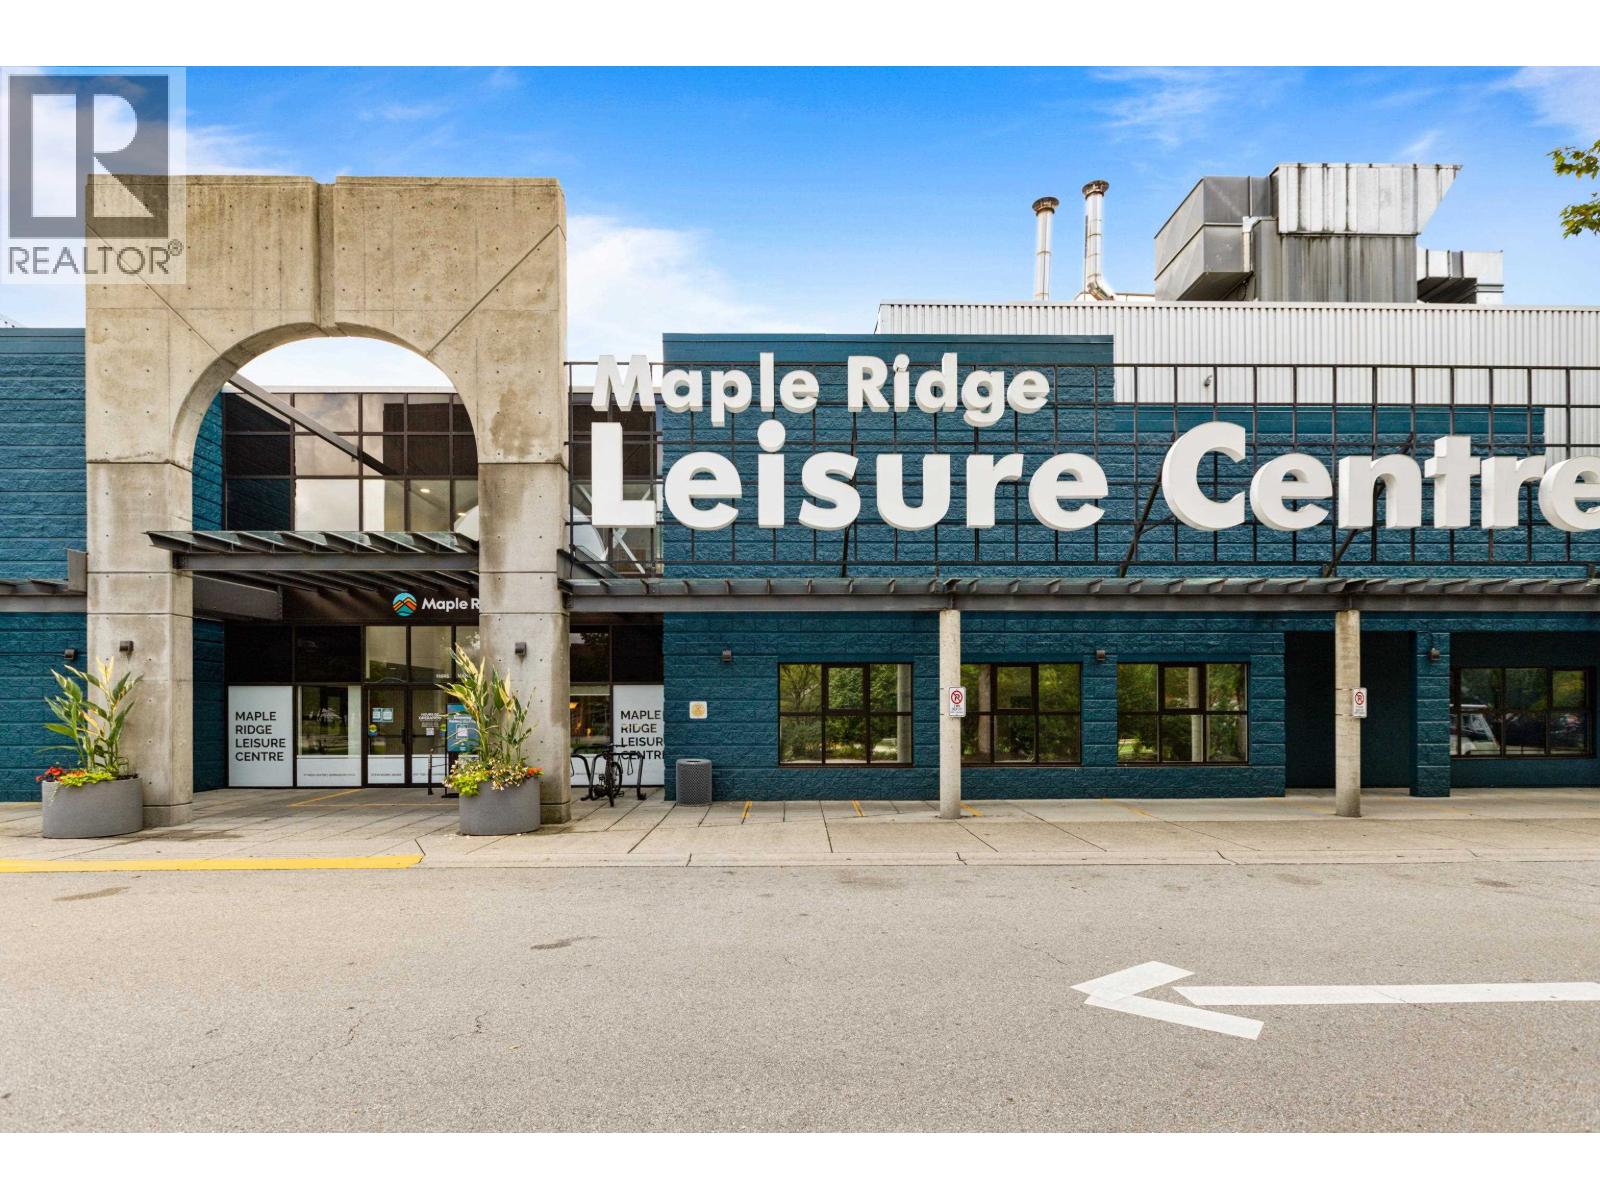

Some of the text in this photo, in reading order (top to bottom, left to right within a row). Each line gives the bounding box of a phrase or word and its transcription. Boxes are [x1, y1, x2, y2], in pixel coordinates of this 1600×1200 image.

[591, 352, 1050, 427] Maple Ridge
[591, 419, 1600, 532] Leisure Centre
[421, 598, 468, 612] Maple
[235, 711, 277, 721] MAPLE
[621, 710, 662, 720] MAPLE
[235, 725, 273, 735] RIDGE
[621, 724, 657, 734] RIDGE
[235, 738, 287, 748] LEISURE
[621, 737, 664, 747] LEISUR
[234, 752, 285, 762] CENTRE
[620, 750, 665, 760] CENTR
